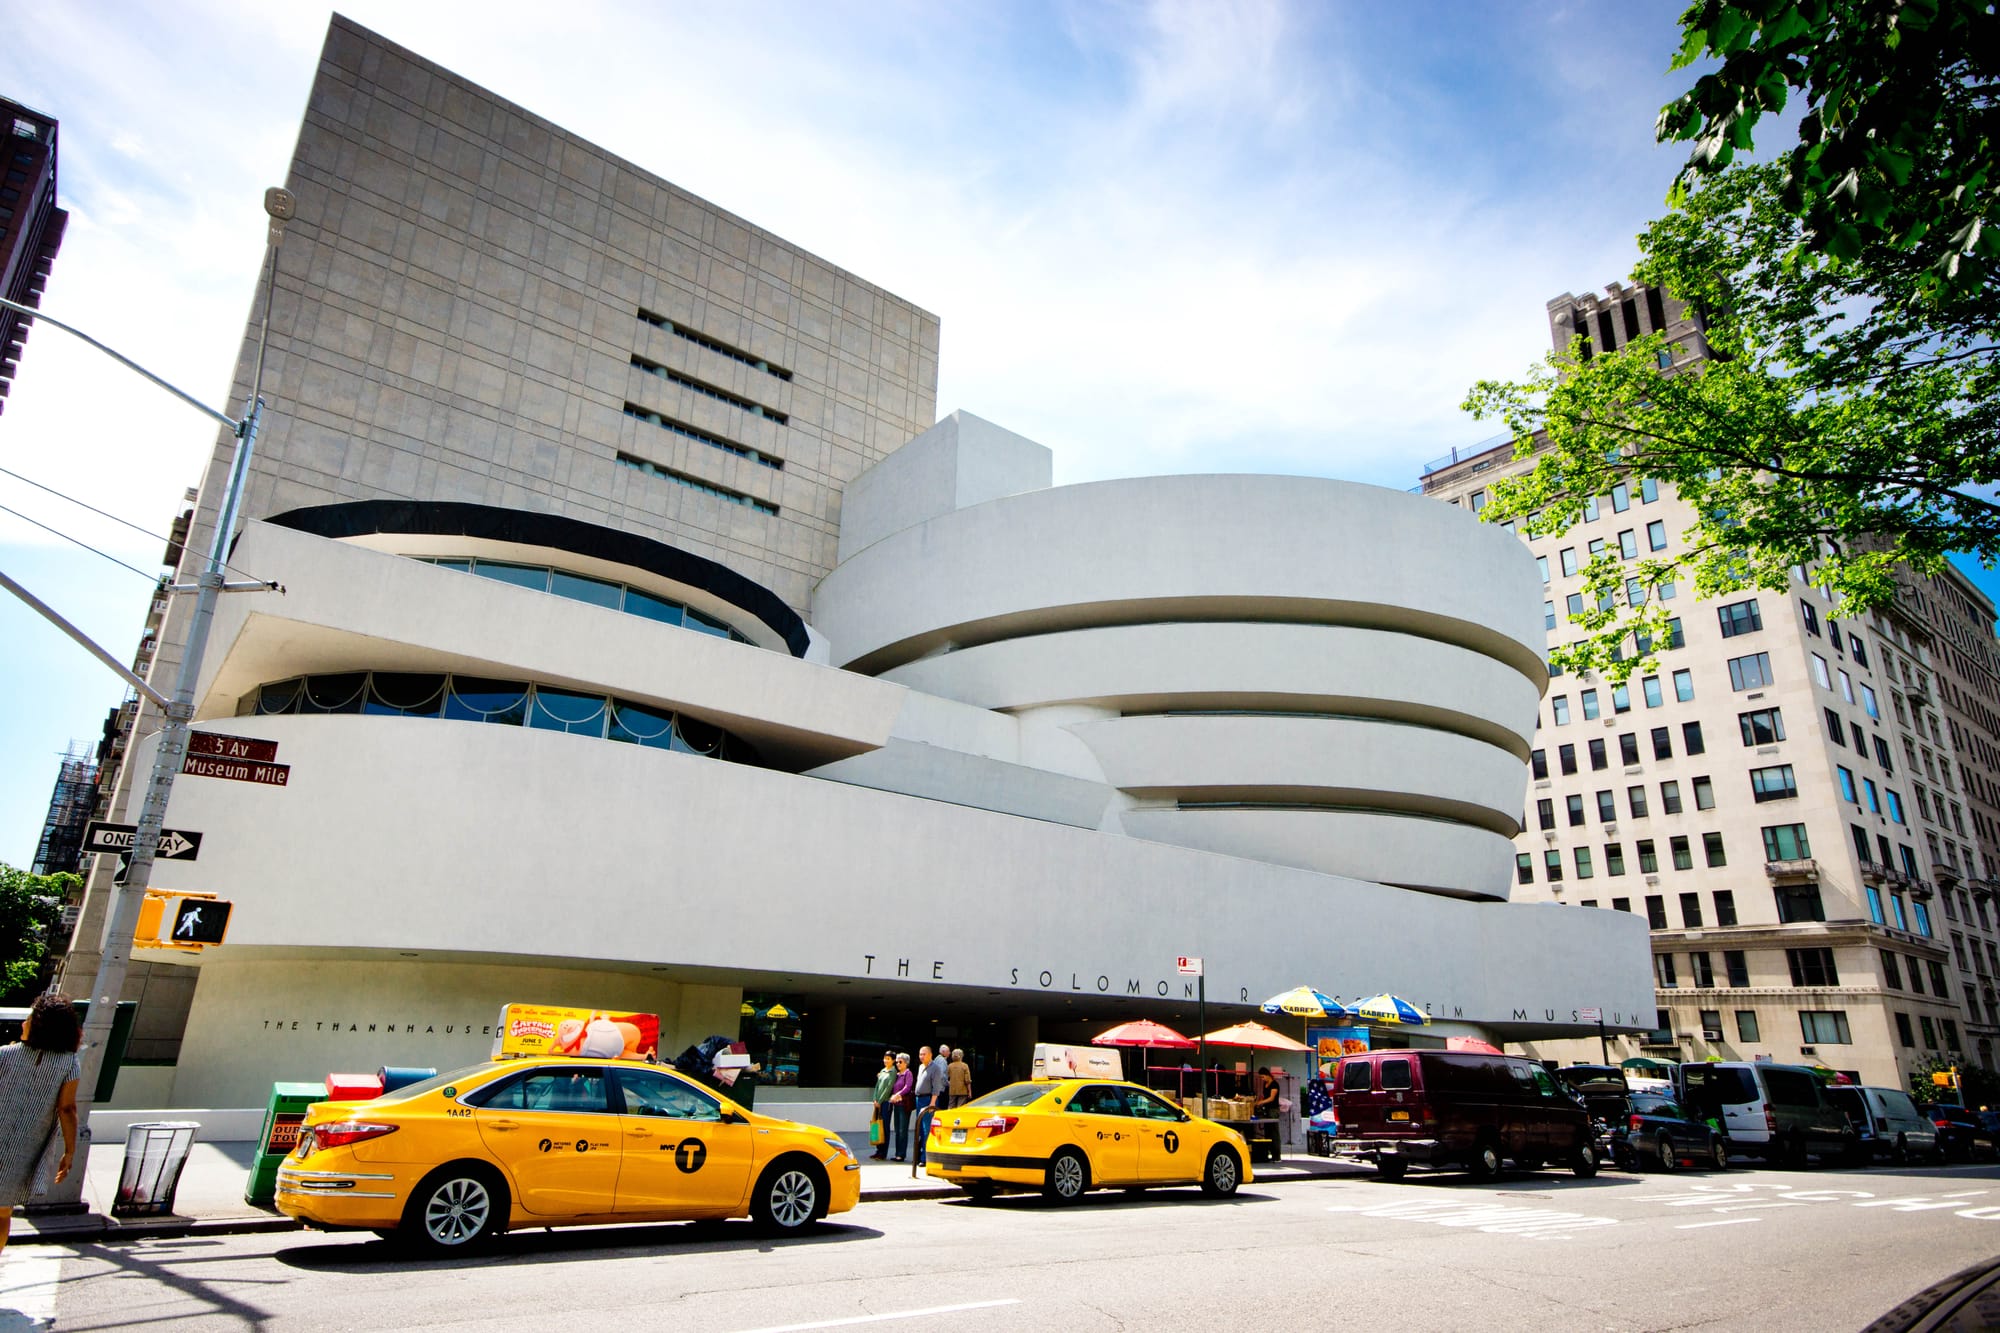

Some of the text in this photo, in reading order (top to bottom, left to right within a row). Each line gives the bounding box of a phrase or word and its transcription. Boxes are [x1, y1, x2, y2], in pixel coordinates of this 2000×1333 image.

[215, 737, 249, 757] 5 Av
[184, 758, 286, 784] Museum Mile
[103, 832, 136, 846] ONE
[864, 955, 1640, 1026] THE SOLOMON R MUSUM
[1361, 1009, 1397, 1019] SABRETT
[263, 1020, 490, 1035] THE THANNHAUSE
[447, 1109, 471, 1118] 1A42
